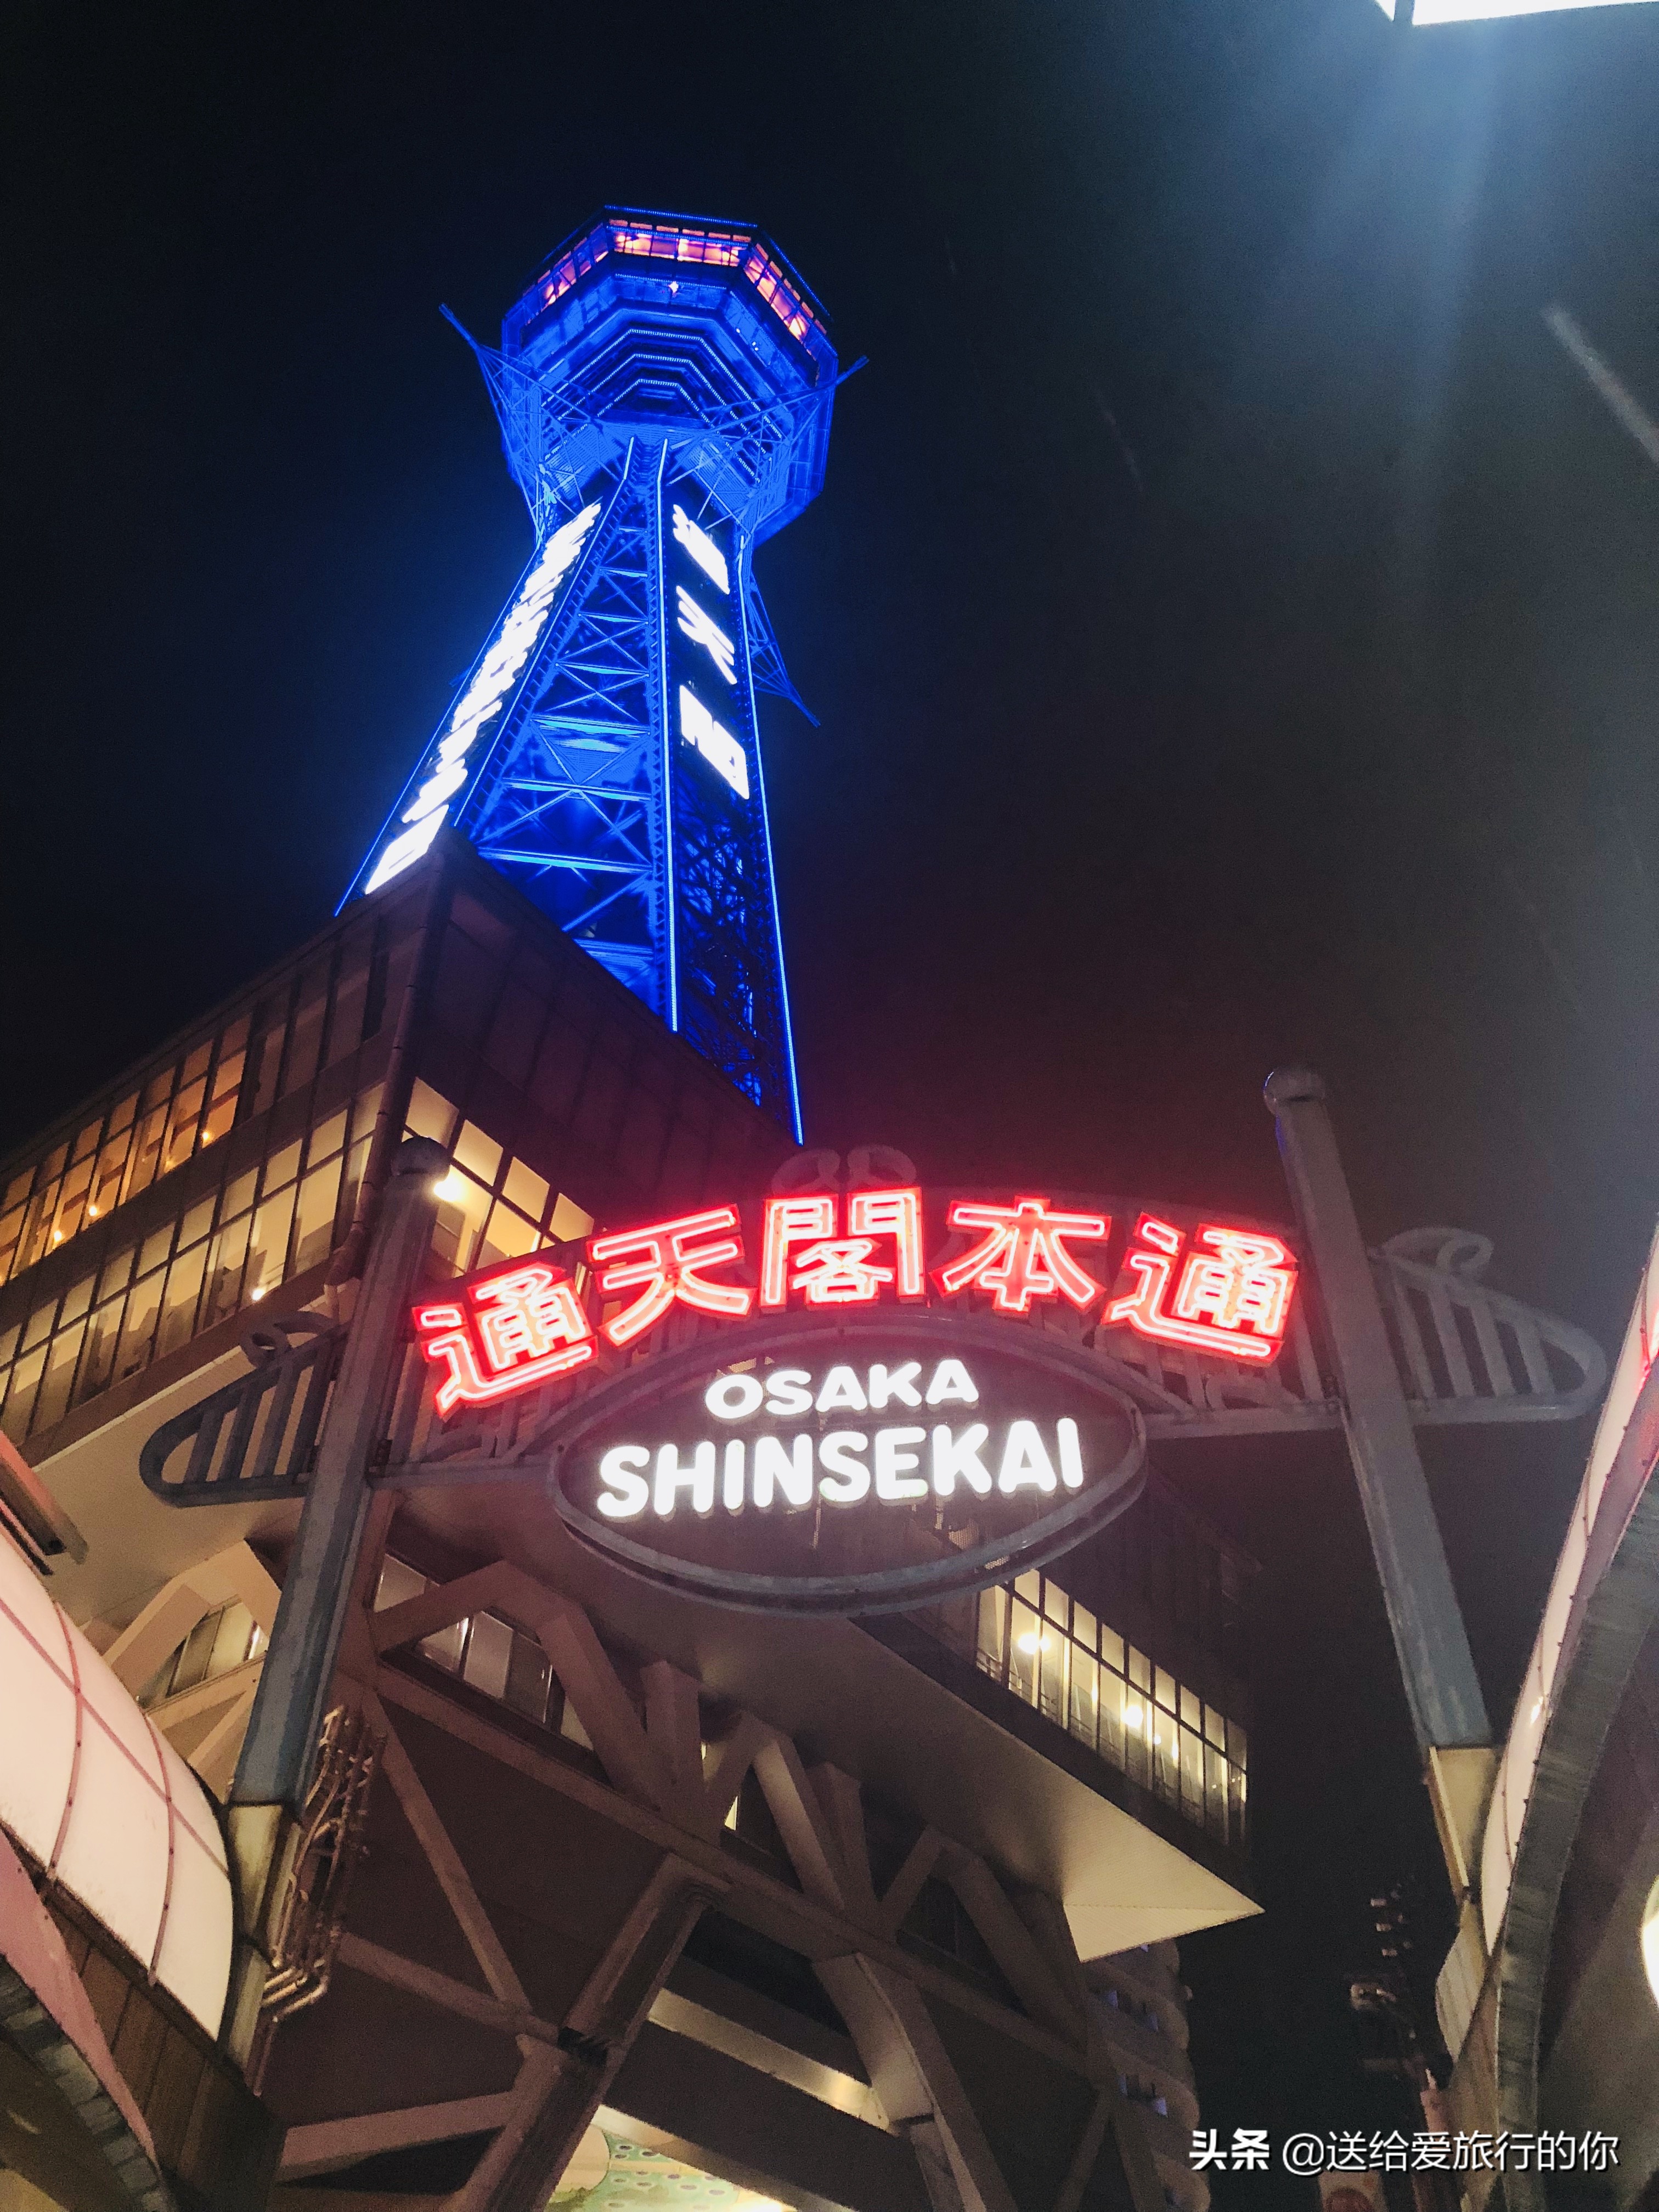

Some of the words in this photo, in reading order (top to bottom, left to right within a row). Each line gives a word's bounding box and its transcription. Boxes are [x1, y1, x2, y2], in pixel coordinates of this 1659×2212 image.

[412, 1185, 1299, 1418] 通天閣本通
[705, 1359, 979, 1419] OSAKA
[597, 1417, 1084, 1518] SHINSEKAI
